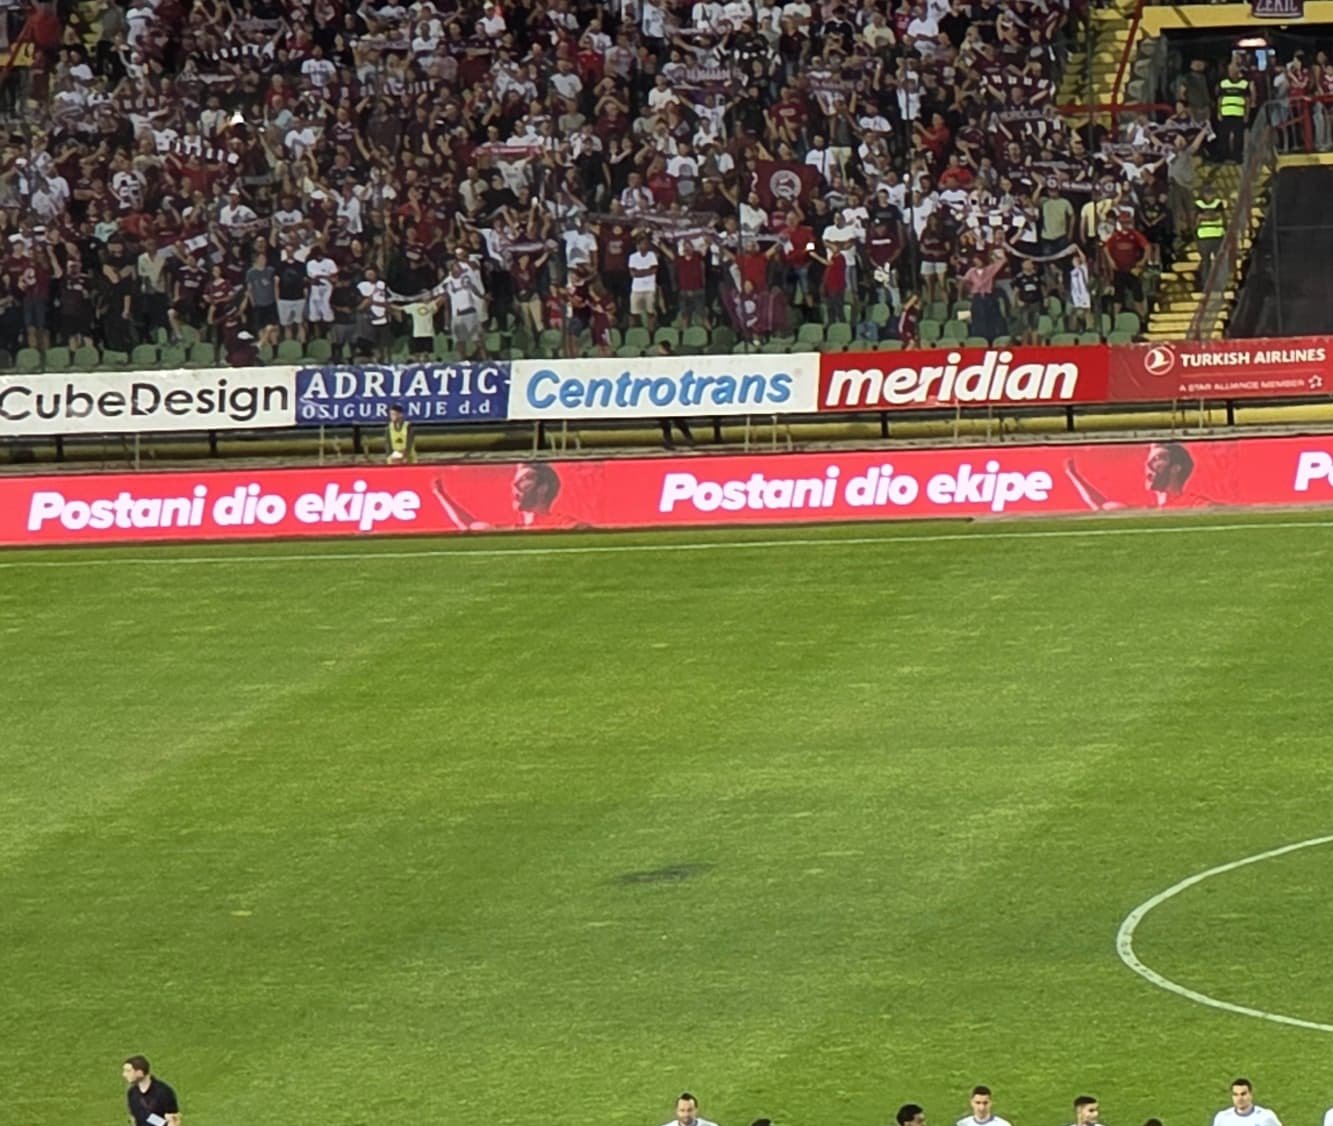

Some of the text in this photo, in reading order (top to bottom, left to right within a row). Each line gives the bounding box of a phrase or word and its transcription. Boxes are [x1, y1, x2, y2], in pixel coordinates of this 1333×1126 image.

[825, 351, 1078, 405] meridian
[1180, 348, 1326, 367] TURKISH AIRLINES
[0, 379, 289, 421] CubeDesign
[303, 368, 499, 399] ADRIATIC
[526, 369, 793, 409] Centrotrans
[302, 401, 448, 418] OSIGURNJE
[27, 480, 421, 532] Postani dio ekipe
[659, 460, 1053, 513] Postani dio ekipe
